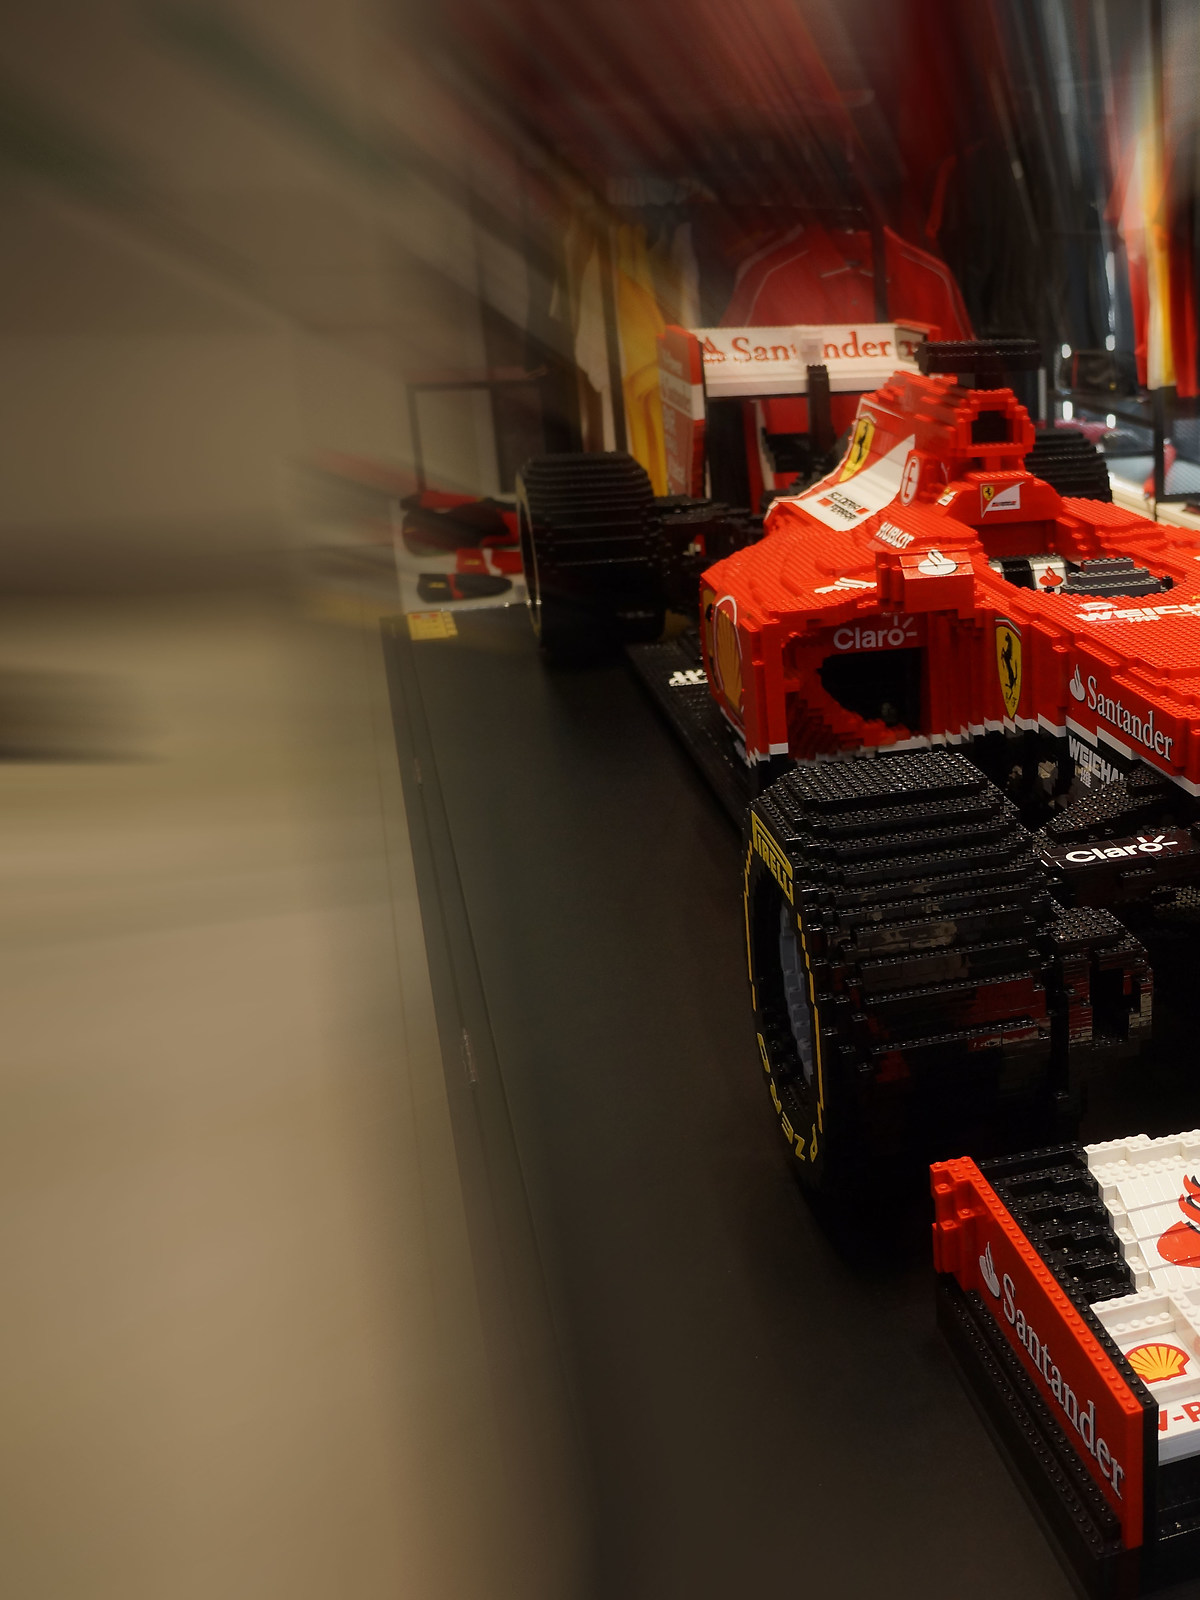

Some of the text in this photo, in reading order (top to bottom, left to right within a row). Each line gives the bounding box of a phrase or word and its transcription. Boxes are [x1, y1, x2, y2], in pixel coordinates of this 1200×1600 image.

[731, 330, 891, 362] Sannder
[875, 521, 915, 549] HUBLOT
[832, 624, 908, 650] Claro
[1087, 675, 1173, 761] Santander
[751, 809, 794, 906] PIRELLI
[1065, 839, 1168, 863] Claro
[1002, 1273, 1125, 1500] Santander
